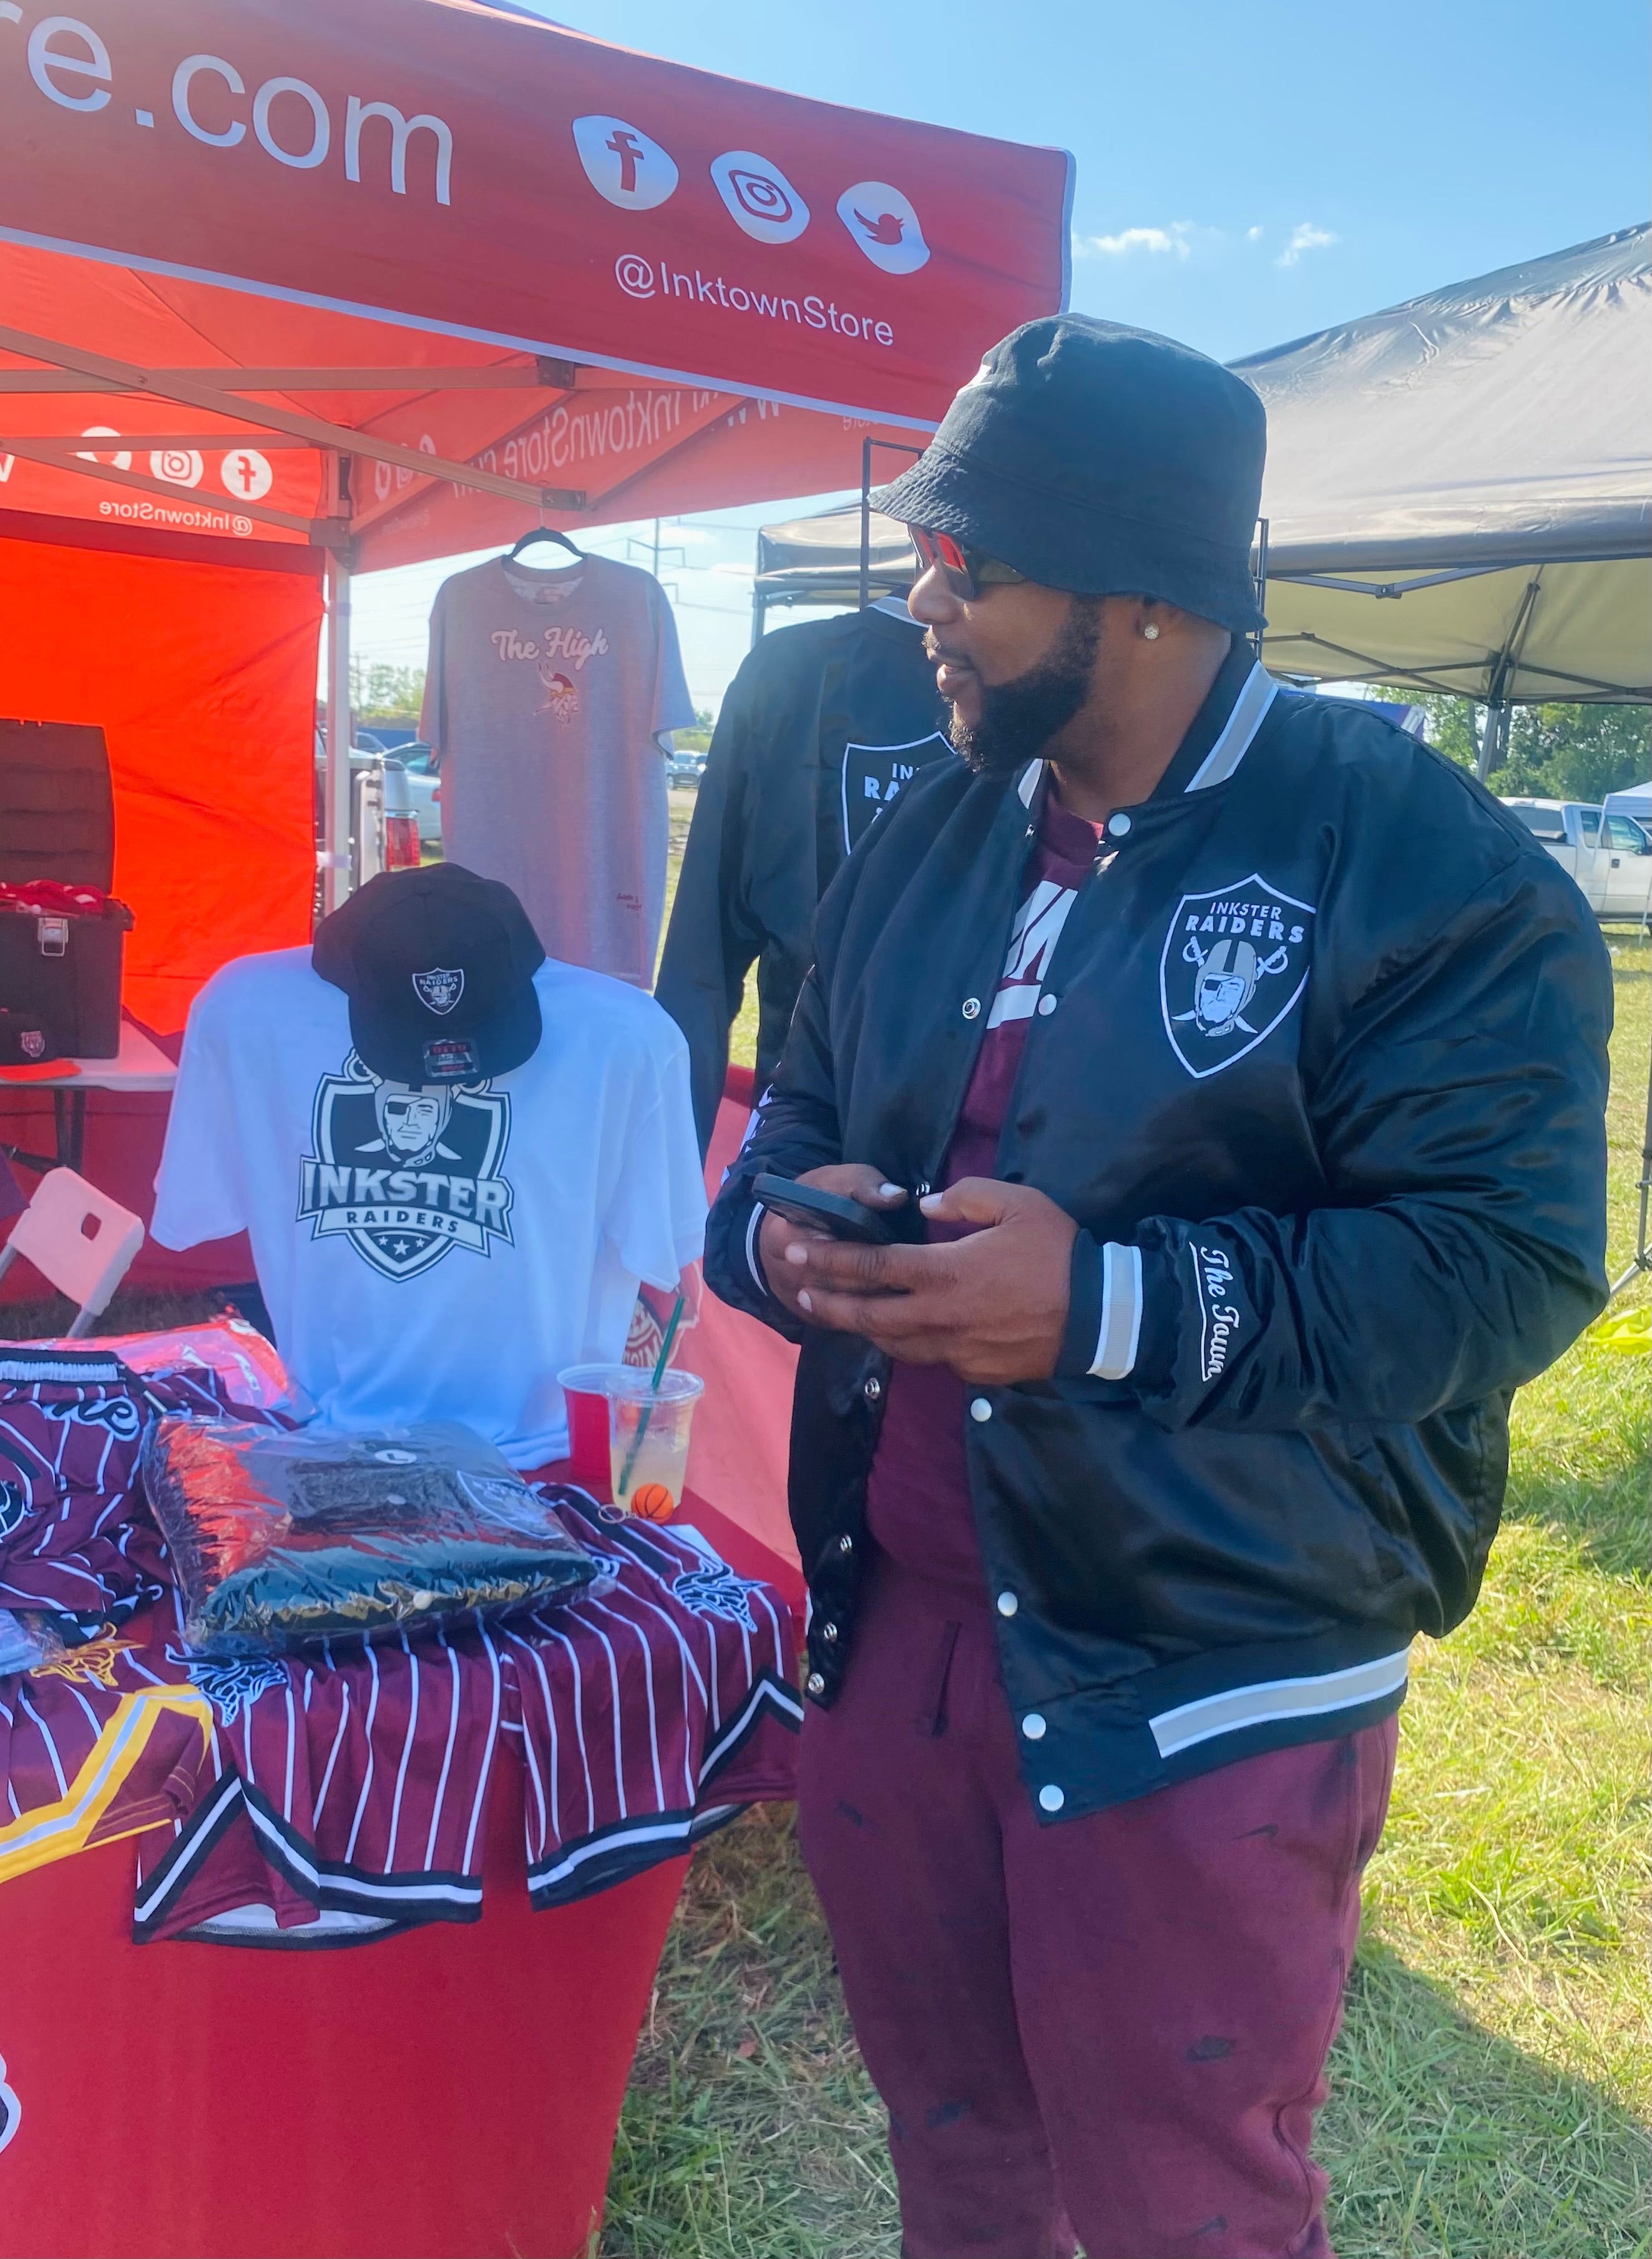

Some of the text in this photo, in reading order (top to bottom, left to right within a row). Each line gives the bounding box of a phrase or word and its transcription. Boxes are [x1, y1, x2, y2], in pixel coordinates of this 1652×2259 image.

[614, 253, 894, 346] @InktownStore
[491, 626, 609, 670] The High
[1185, 914, 1306, 944] RAIDERS
[1210, 902, 1282, 920] INKSTER
[419, 976, 459, 986] RAIDERS
[303, 1162, 510, 1232] INKSTER
[346, 1210, 459, 1233] RAIDERS
[1200, 1246, 1240, 1376] The Town
